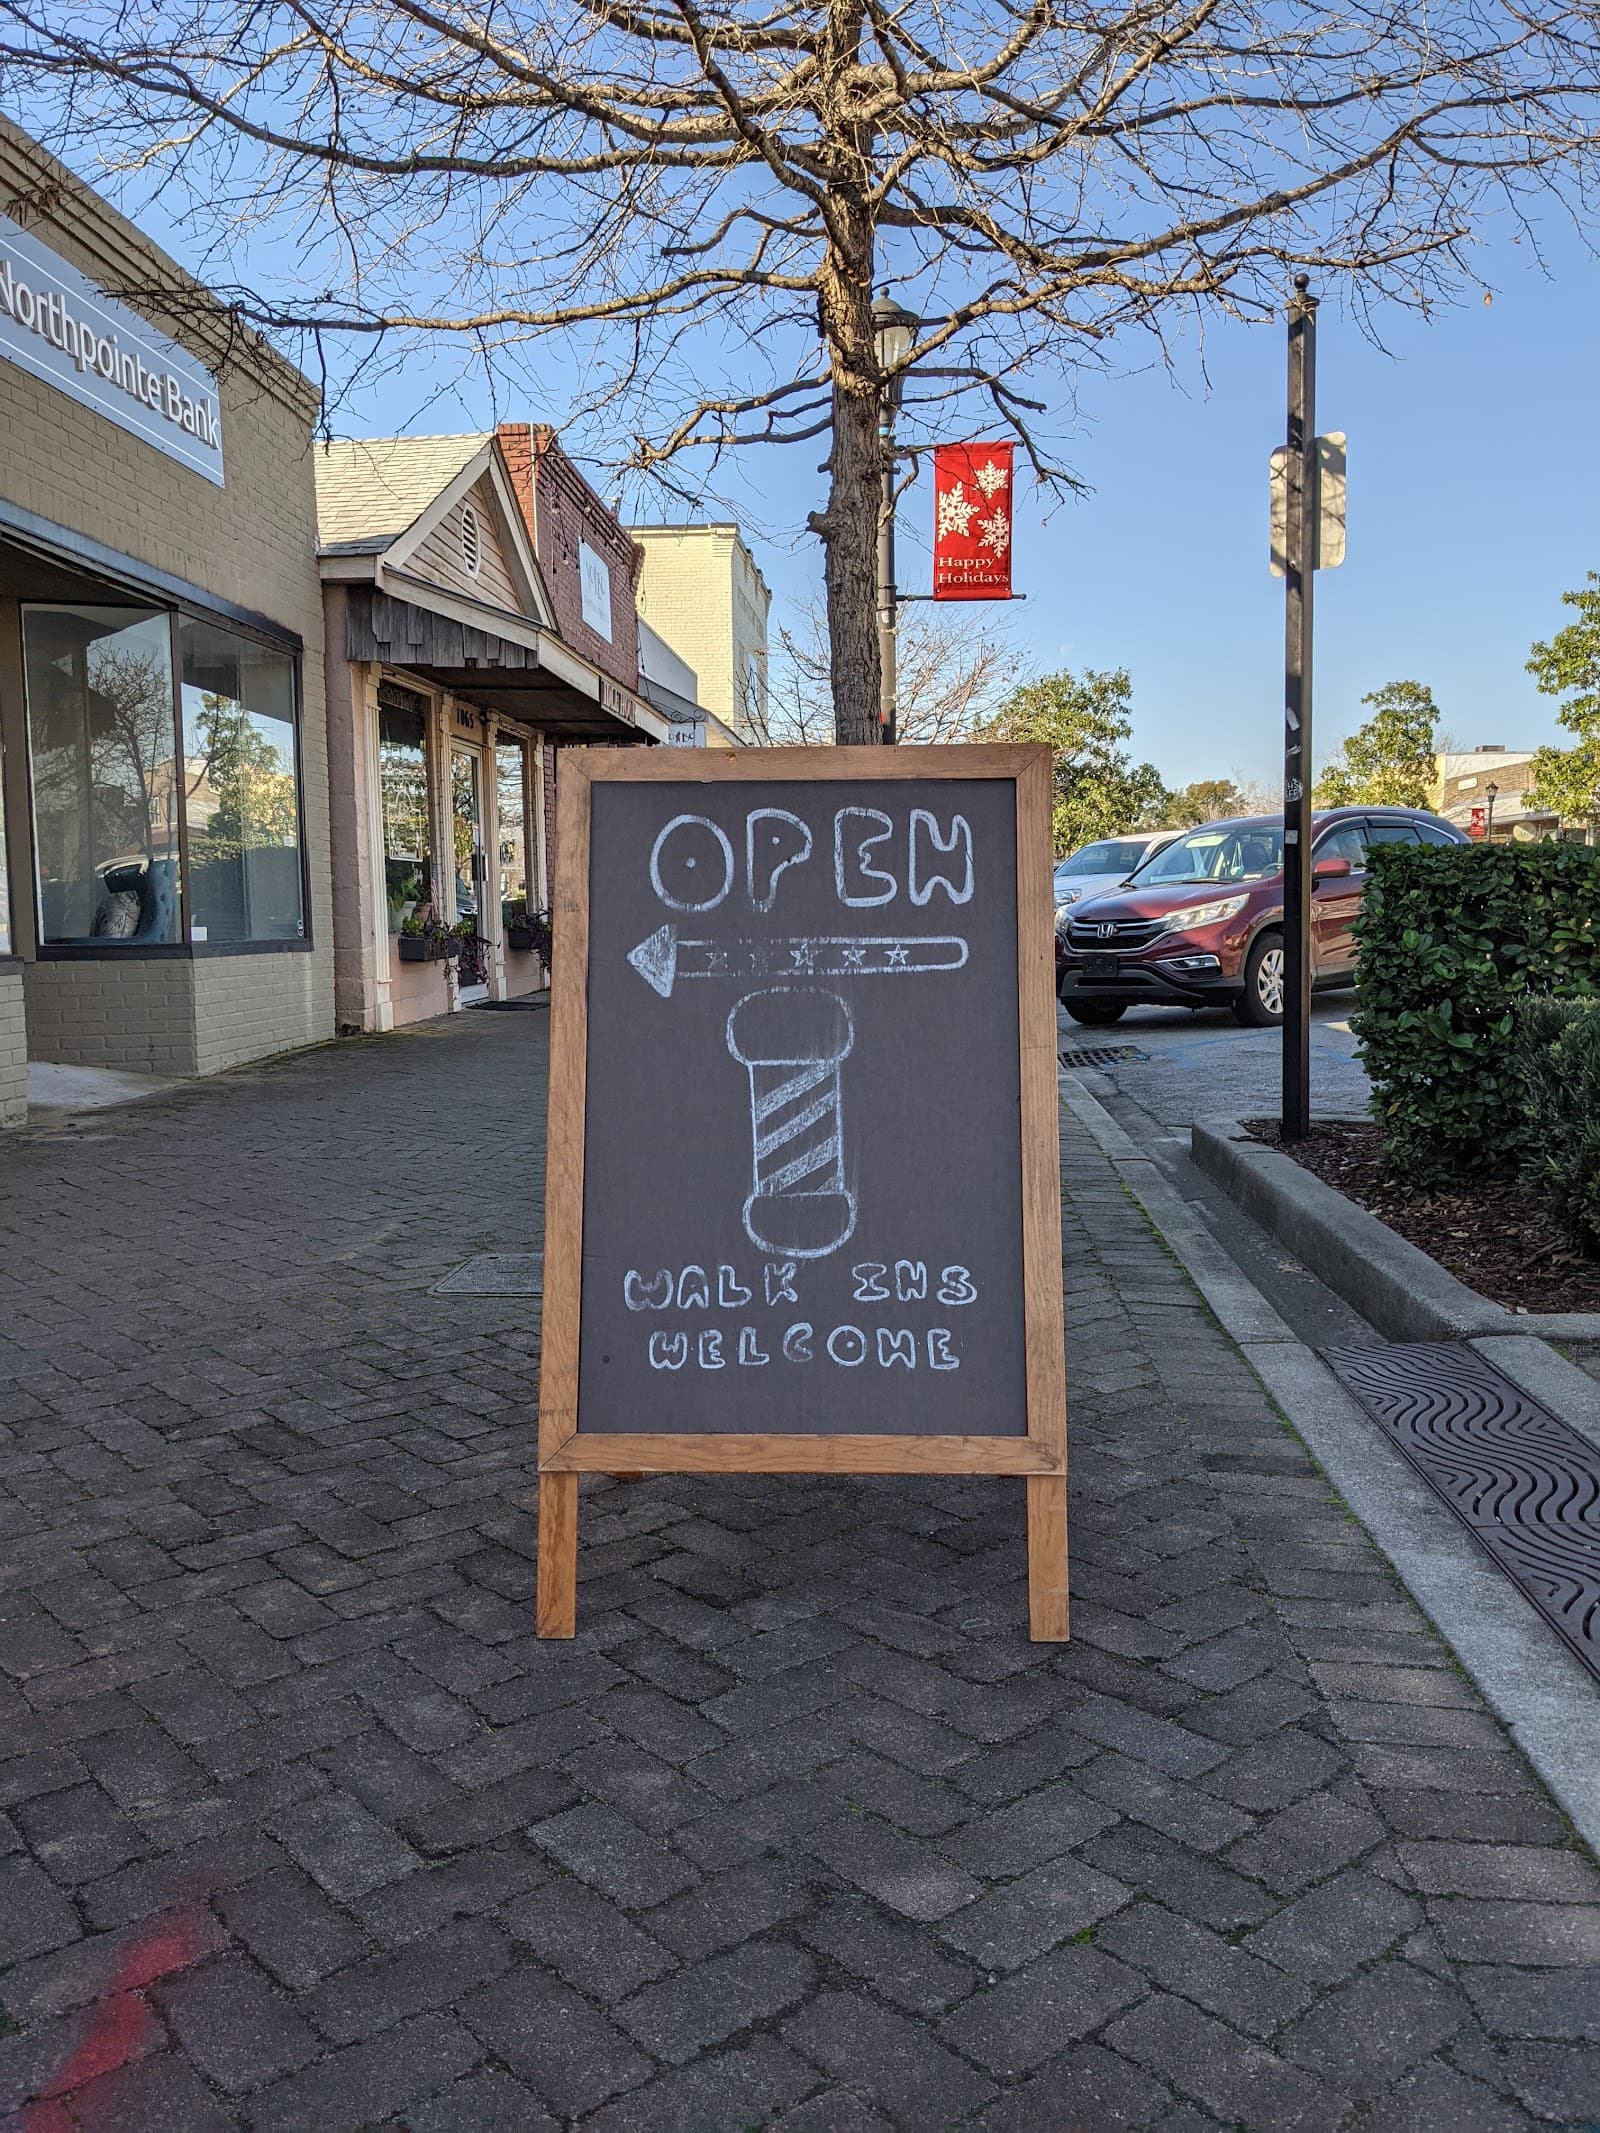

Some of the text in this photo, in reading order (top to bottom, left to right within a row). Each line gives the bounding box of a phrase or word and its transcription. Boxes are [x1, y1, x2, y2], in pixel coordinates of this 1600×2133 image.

[0, 260, 221, 450] Northpointe Bank
[938, 556, 995, 569] Happy
[938, 571, 1009, 586] Holidays
[648, 806, 976, 913] OPEN
[623, 1259, 978, 1311] WALK INS
[648, 1321, 961, 1371] WELCOME
